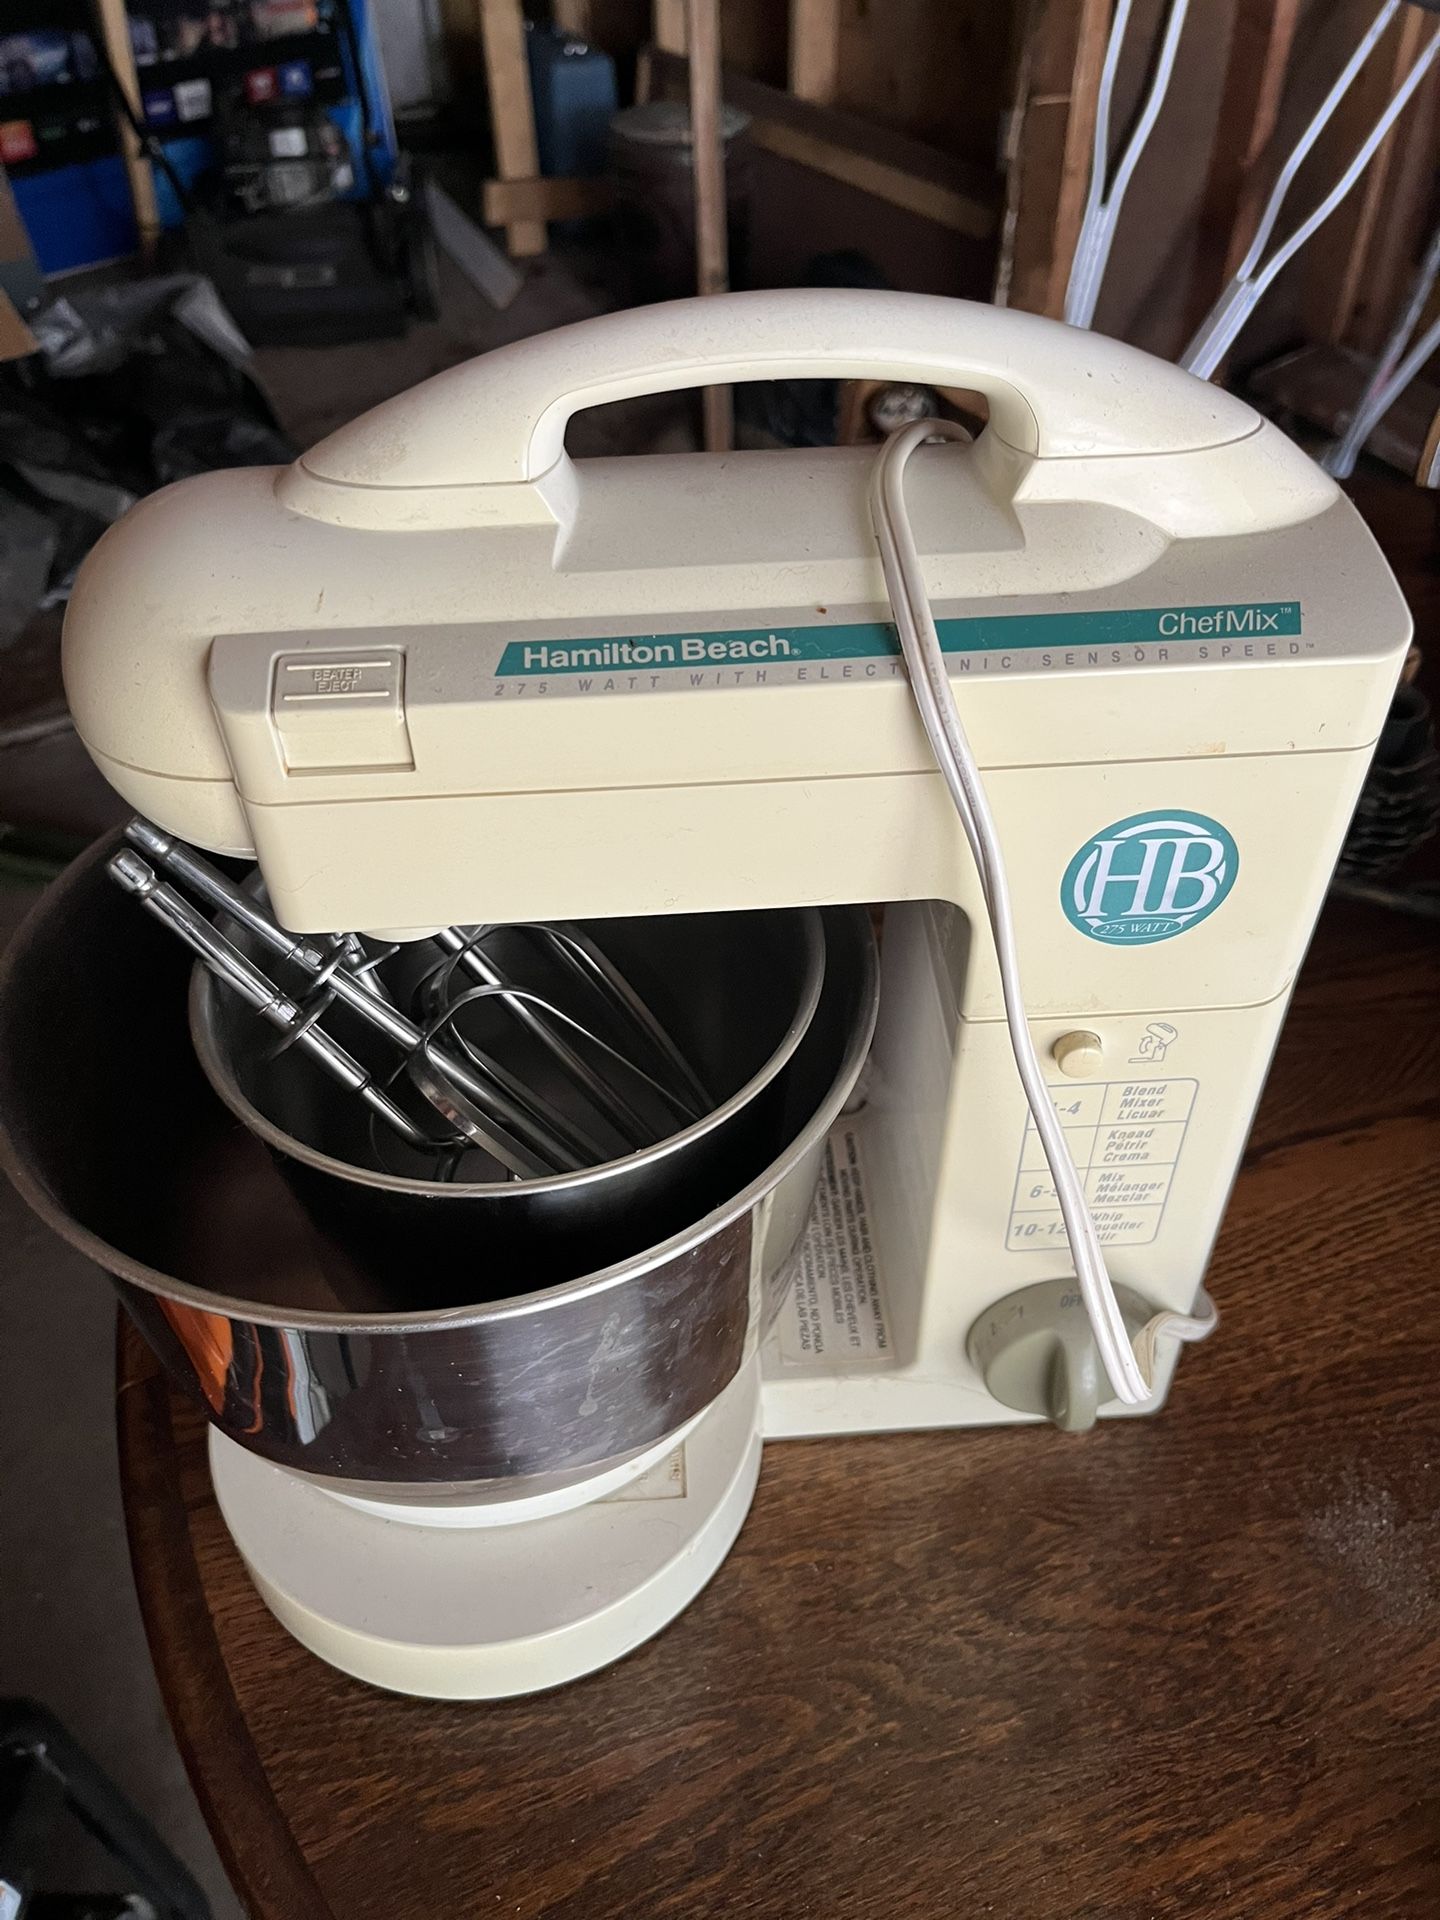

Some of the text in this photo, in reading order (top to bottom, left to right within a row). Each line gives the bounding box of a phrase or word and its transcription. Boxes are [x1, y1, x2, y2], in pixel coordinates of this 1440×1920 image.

[523, 642, 674, 669] Hamilton
[312, 668, 362, 682] BEATER
[495, 682, 548, 696] 275
[578, 676, 659, 692] WATT
[690, 670, 768, 687] WITH
[797, 656, 1012, 680] ELECTNIC
[1042, 649, 1169, 666] SENSOR
[317, 680, 358, 693] EJECT
[1077, 837, 1224, 917] HB
[1100, 921, 1174, 934] 275 WATT
[1122, 1084, 1167, 1097] Blend
[1120, 1097, 1164, 1109] Mixer
[1116, 1109, 1165, 1120] Licuar
[1107, 1128, 1155, 1141] Knead
[1102, 1151, 1150, 1162] Crema
[1098, 1172, 1125, 1183] Mix
[1095, 1180, 1164, 1193] Mélanger
[1093, 1192, 1150, 1203] Mezclar
[1014, 1222, 1067, 1236] 10-12
[1092, 1221, 1144, 1231] ouetter
